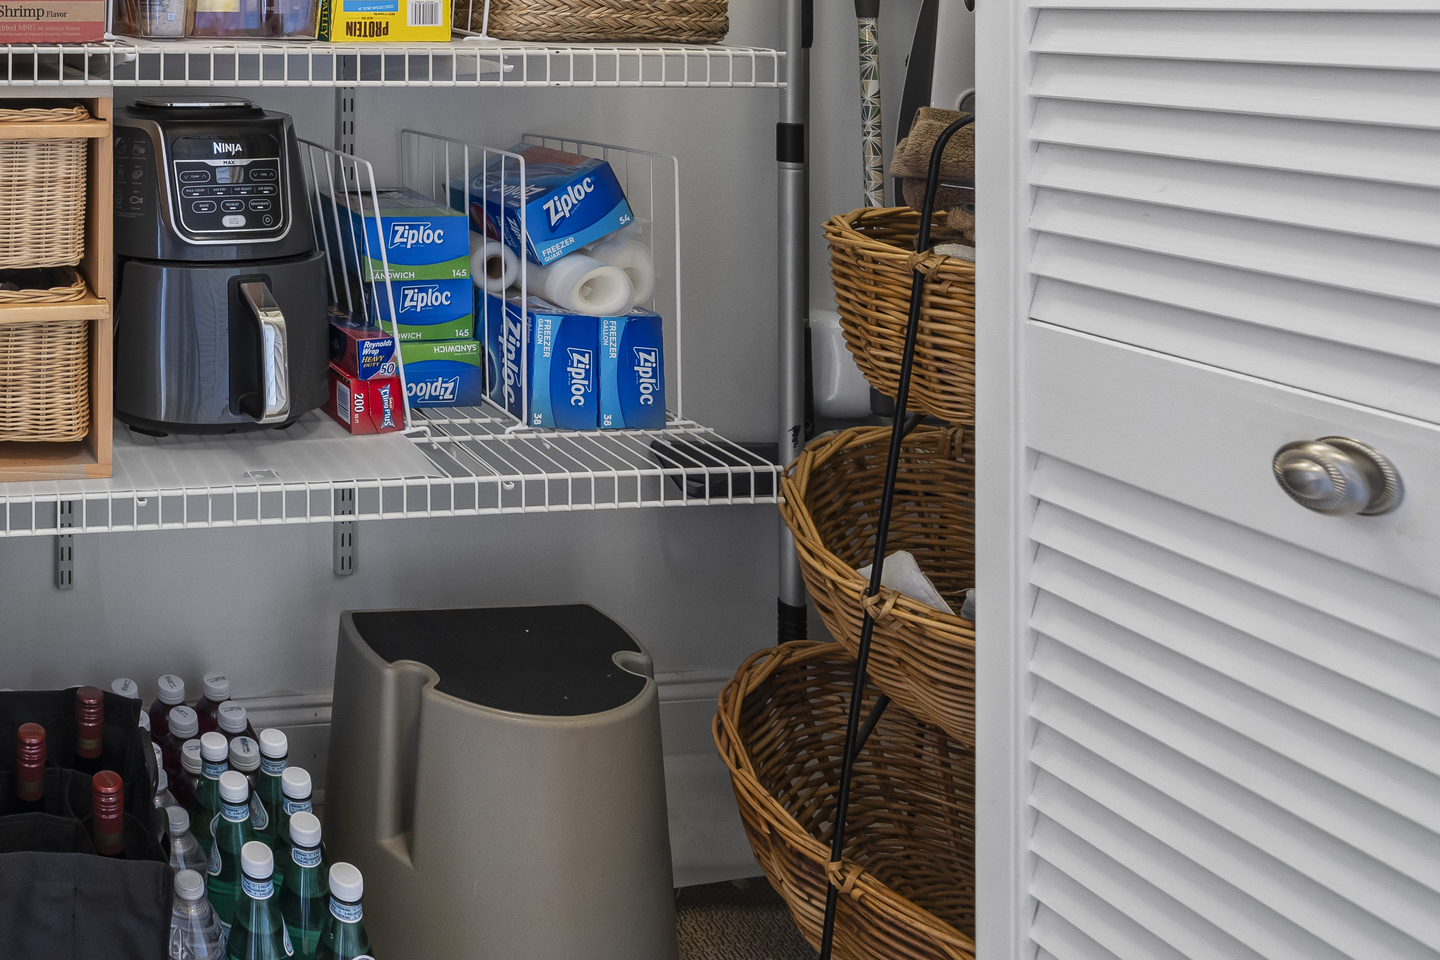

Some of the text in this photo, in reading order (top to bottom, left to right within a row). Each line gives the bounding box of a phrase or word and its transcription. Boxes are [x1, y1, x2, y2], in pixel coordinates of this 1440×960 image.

[46, 10, 68, 18] Flavor
[345, 21, 390, 38] PROTEIN
[212, 141, 243, 156] NINJA
[543, 176, 594, 227] Ziploc
[619, 214, 631, 225] 54
[393, 225, 444, 249] Ziploc
[541, 236, 575, 257] FREEZER
[544, 250, 563, 262] QUART
[369, 271, 415, 280] SANDWICH
[452, 269, 467, 277] 145
[403, 289, 451, 312] Ziploc
[455, 329, 470, 337] 145
[542, 319, 552, 358] FREEZER
[608, 320, 617, 359] FREEZER
[364, 340, 393, 349] Reynolds
[433, 345, 477, 354] SANDWICH
[361, 355, 385, 363] HEAVY
[362, 348, 380, 356] Wrap
[380, 363, 395, 375] 50
[566, 353, 590, 406] Ziploc
[634, 351, 657, 405] Ziploc
[407, 378, 454, 399] Ziploc
[354, 393, 364, 413] 200
[381, 389, 389, 408] Cling
[533, 413, 543, 425] 38
[603, 413, 612, 426] 38
